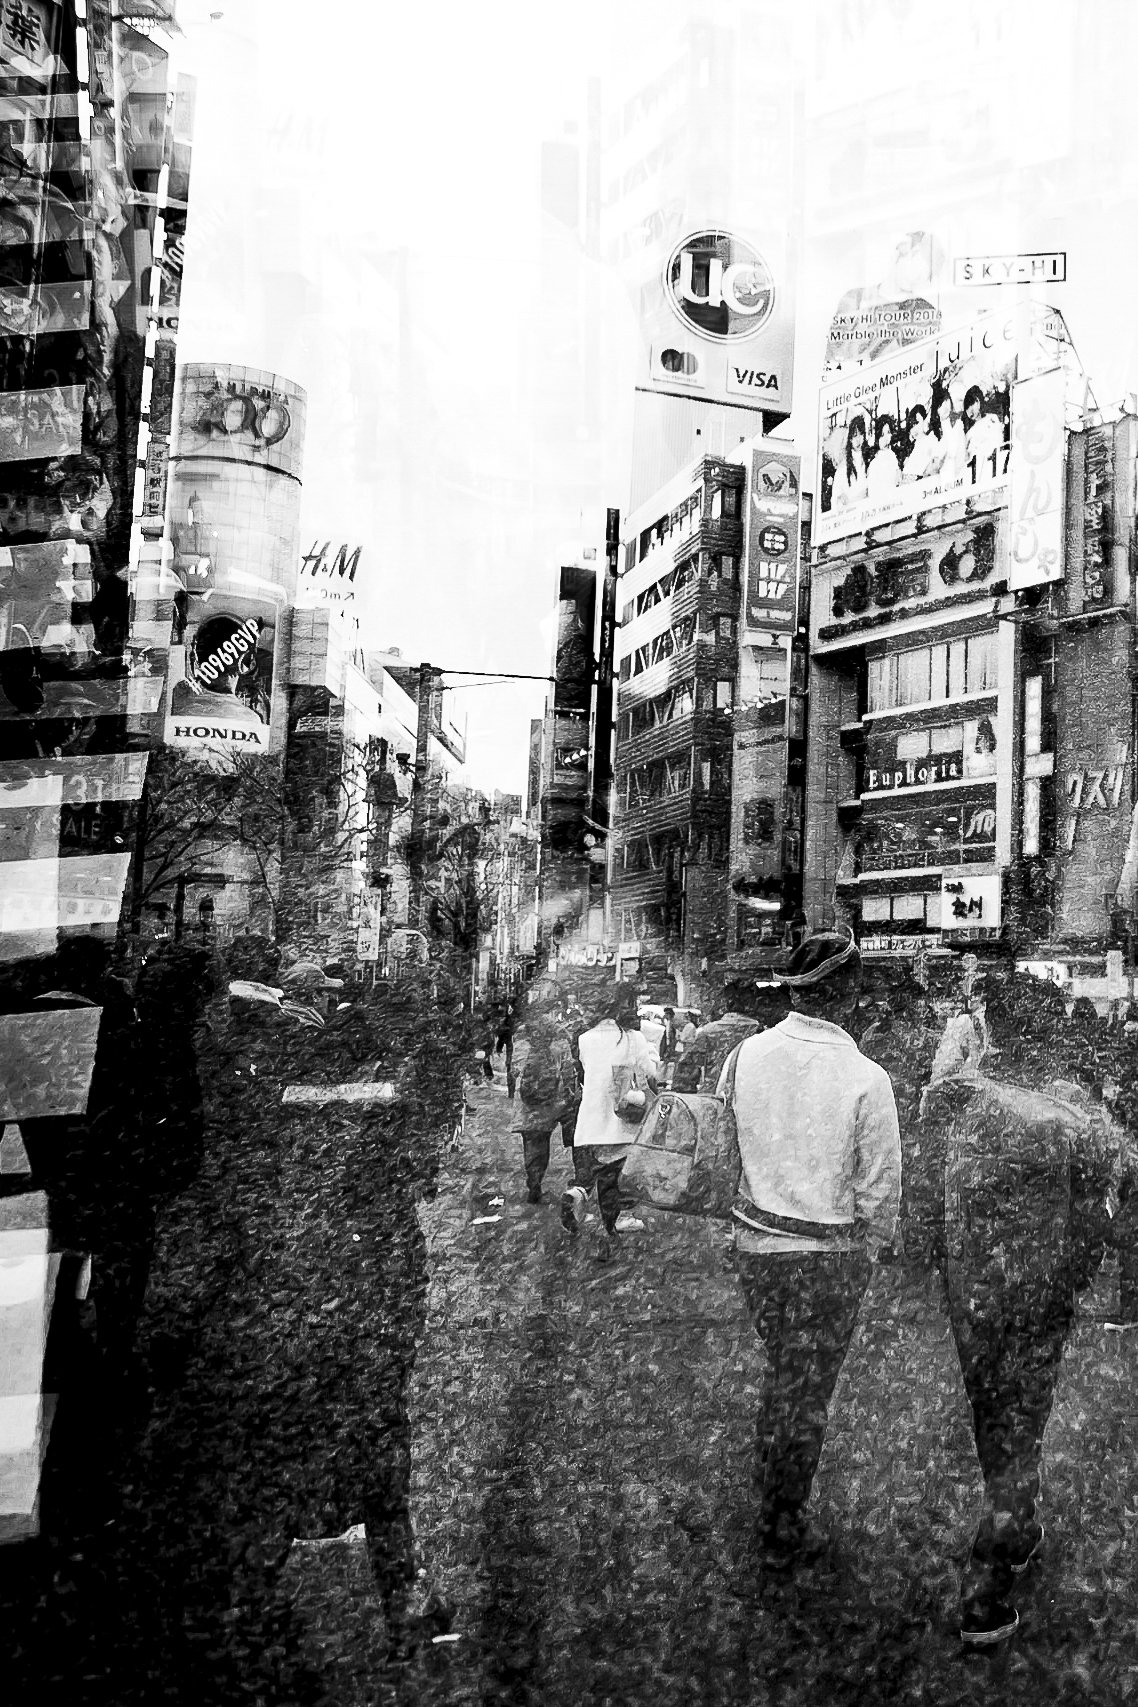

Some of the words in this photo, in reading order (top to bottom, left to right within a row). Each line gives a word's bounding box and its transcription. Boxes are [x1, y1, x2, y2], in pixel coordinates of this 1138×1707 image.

[963, 259, 1057, 281] SKY-HI
[877, 312, 911, 323] TOUR
[830, 328, 874, 341] Marble
[879, 328, 899, 338] the
[933, 320, 1014, 380] juice
[733, 366, 779, 391] VISA
[826, 392, 852, 411] Little
[854, 385, 877, 399] Glee
[879, 362, 925, 390] Monster
[173, 726, 262, 745] HONDA
[868, 759, 957, 790] Euphoria
